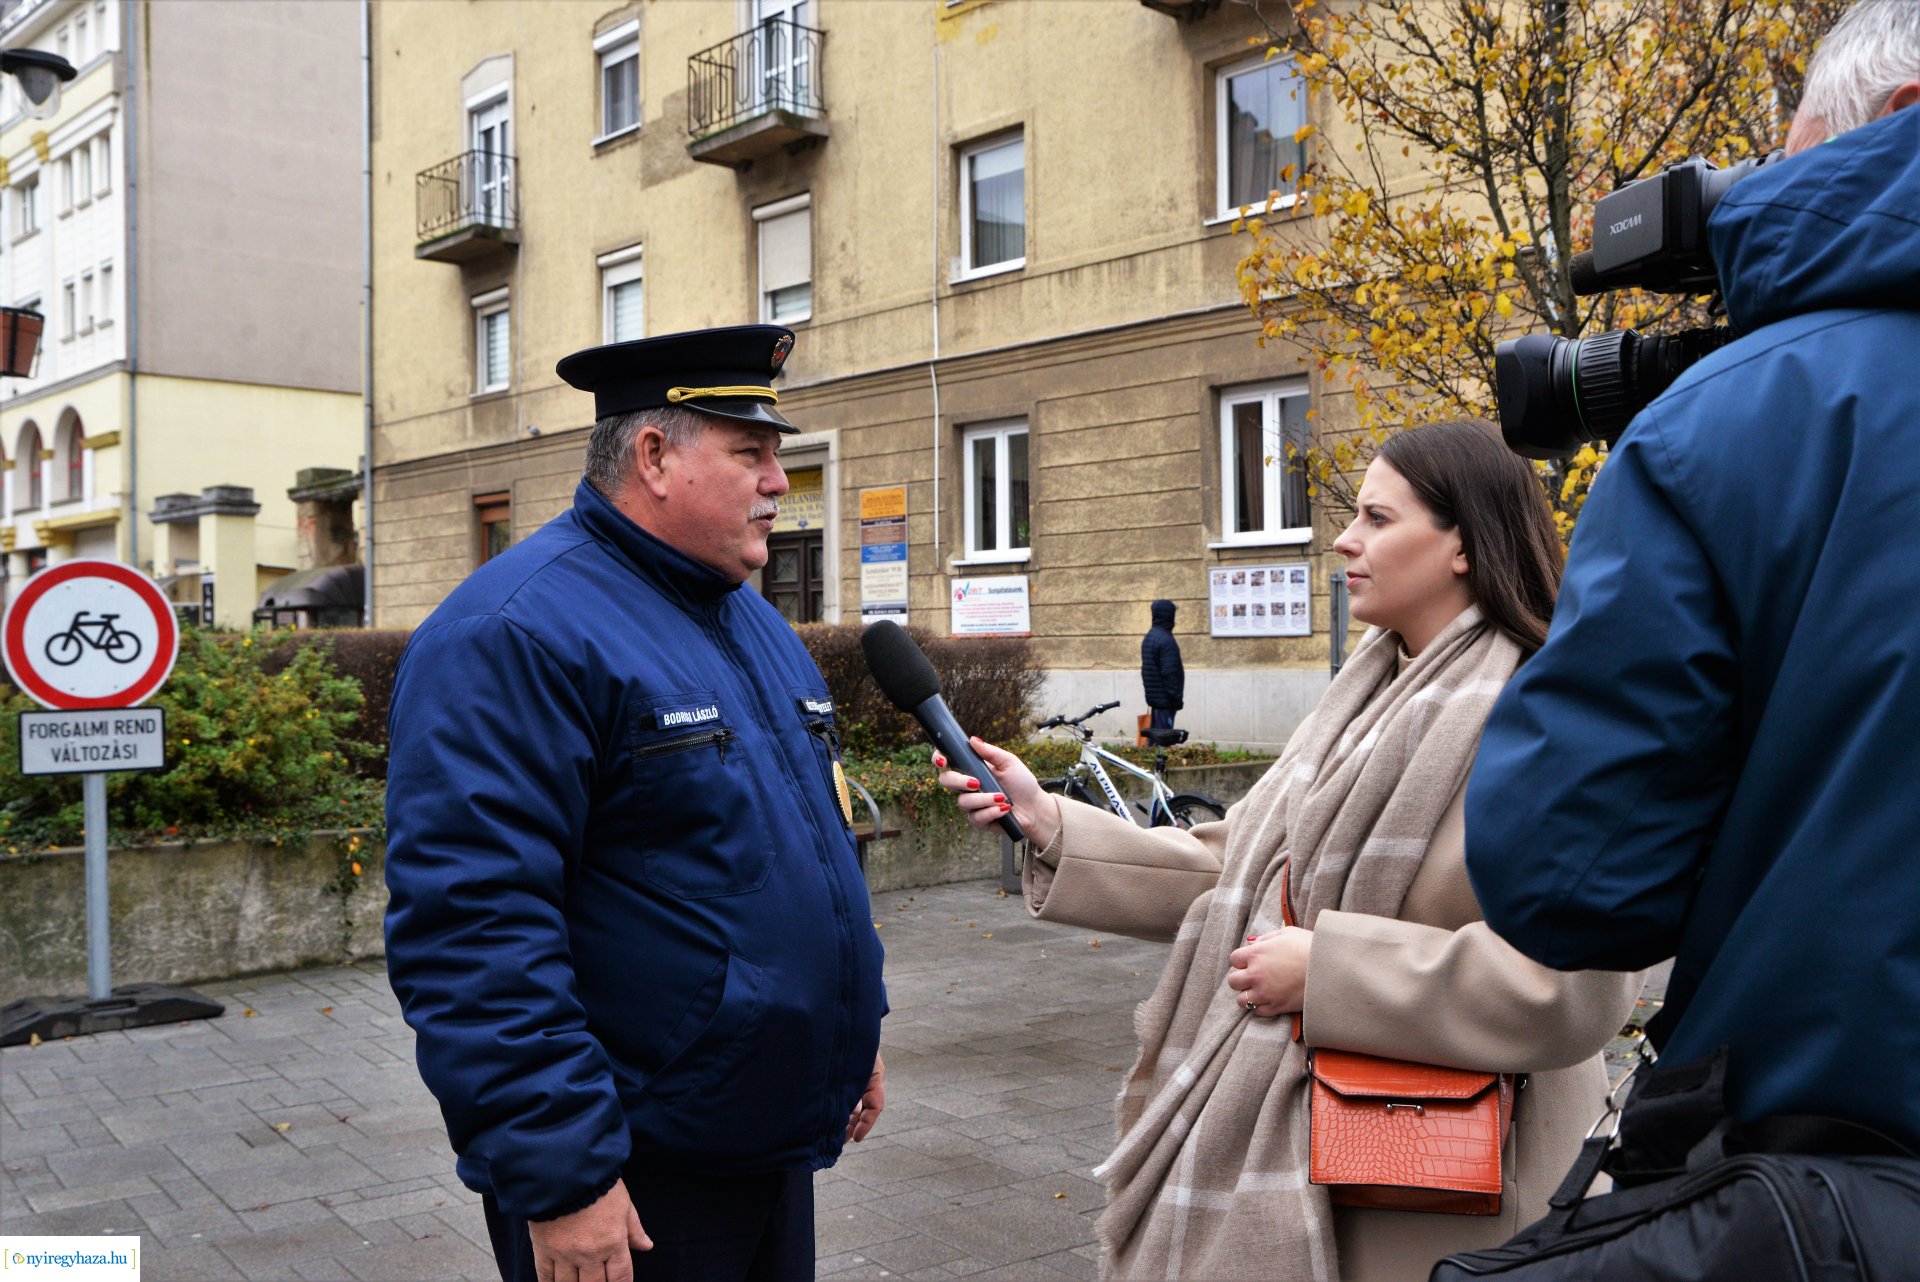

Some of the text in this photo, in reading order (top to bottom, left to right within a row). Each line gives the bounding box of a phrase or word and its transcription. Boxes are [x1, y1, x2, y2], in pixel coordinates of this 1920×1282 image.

[1609, 213, 1642, 236] XDCAM
[692, 704, 719, 722] LÁSZLÓ
[28, 718, 157, 740] FORGALMI REND
[51, 738, 139, 764] VÁLTOZÁSI
